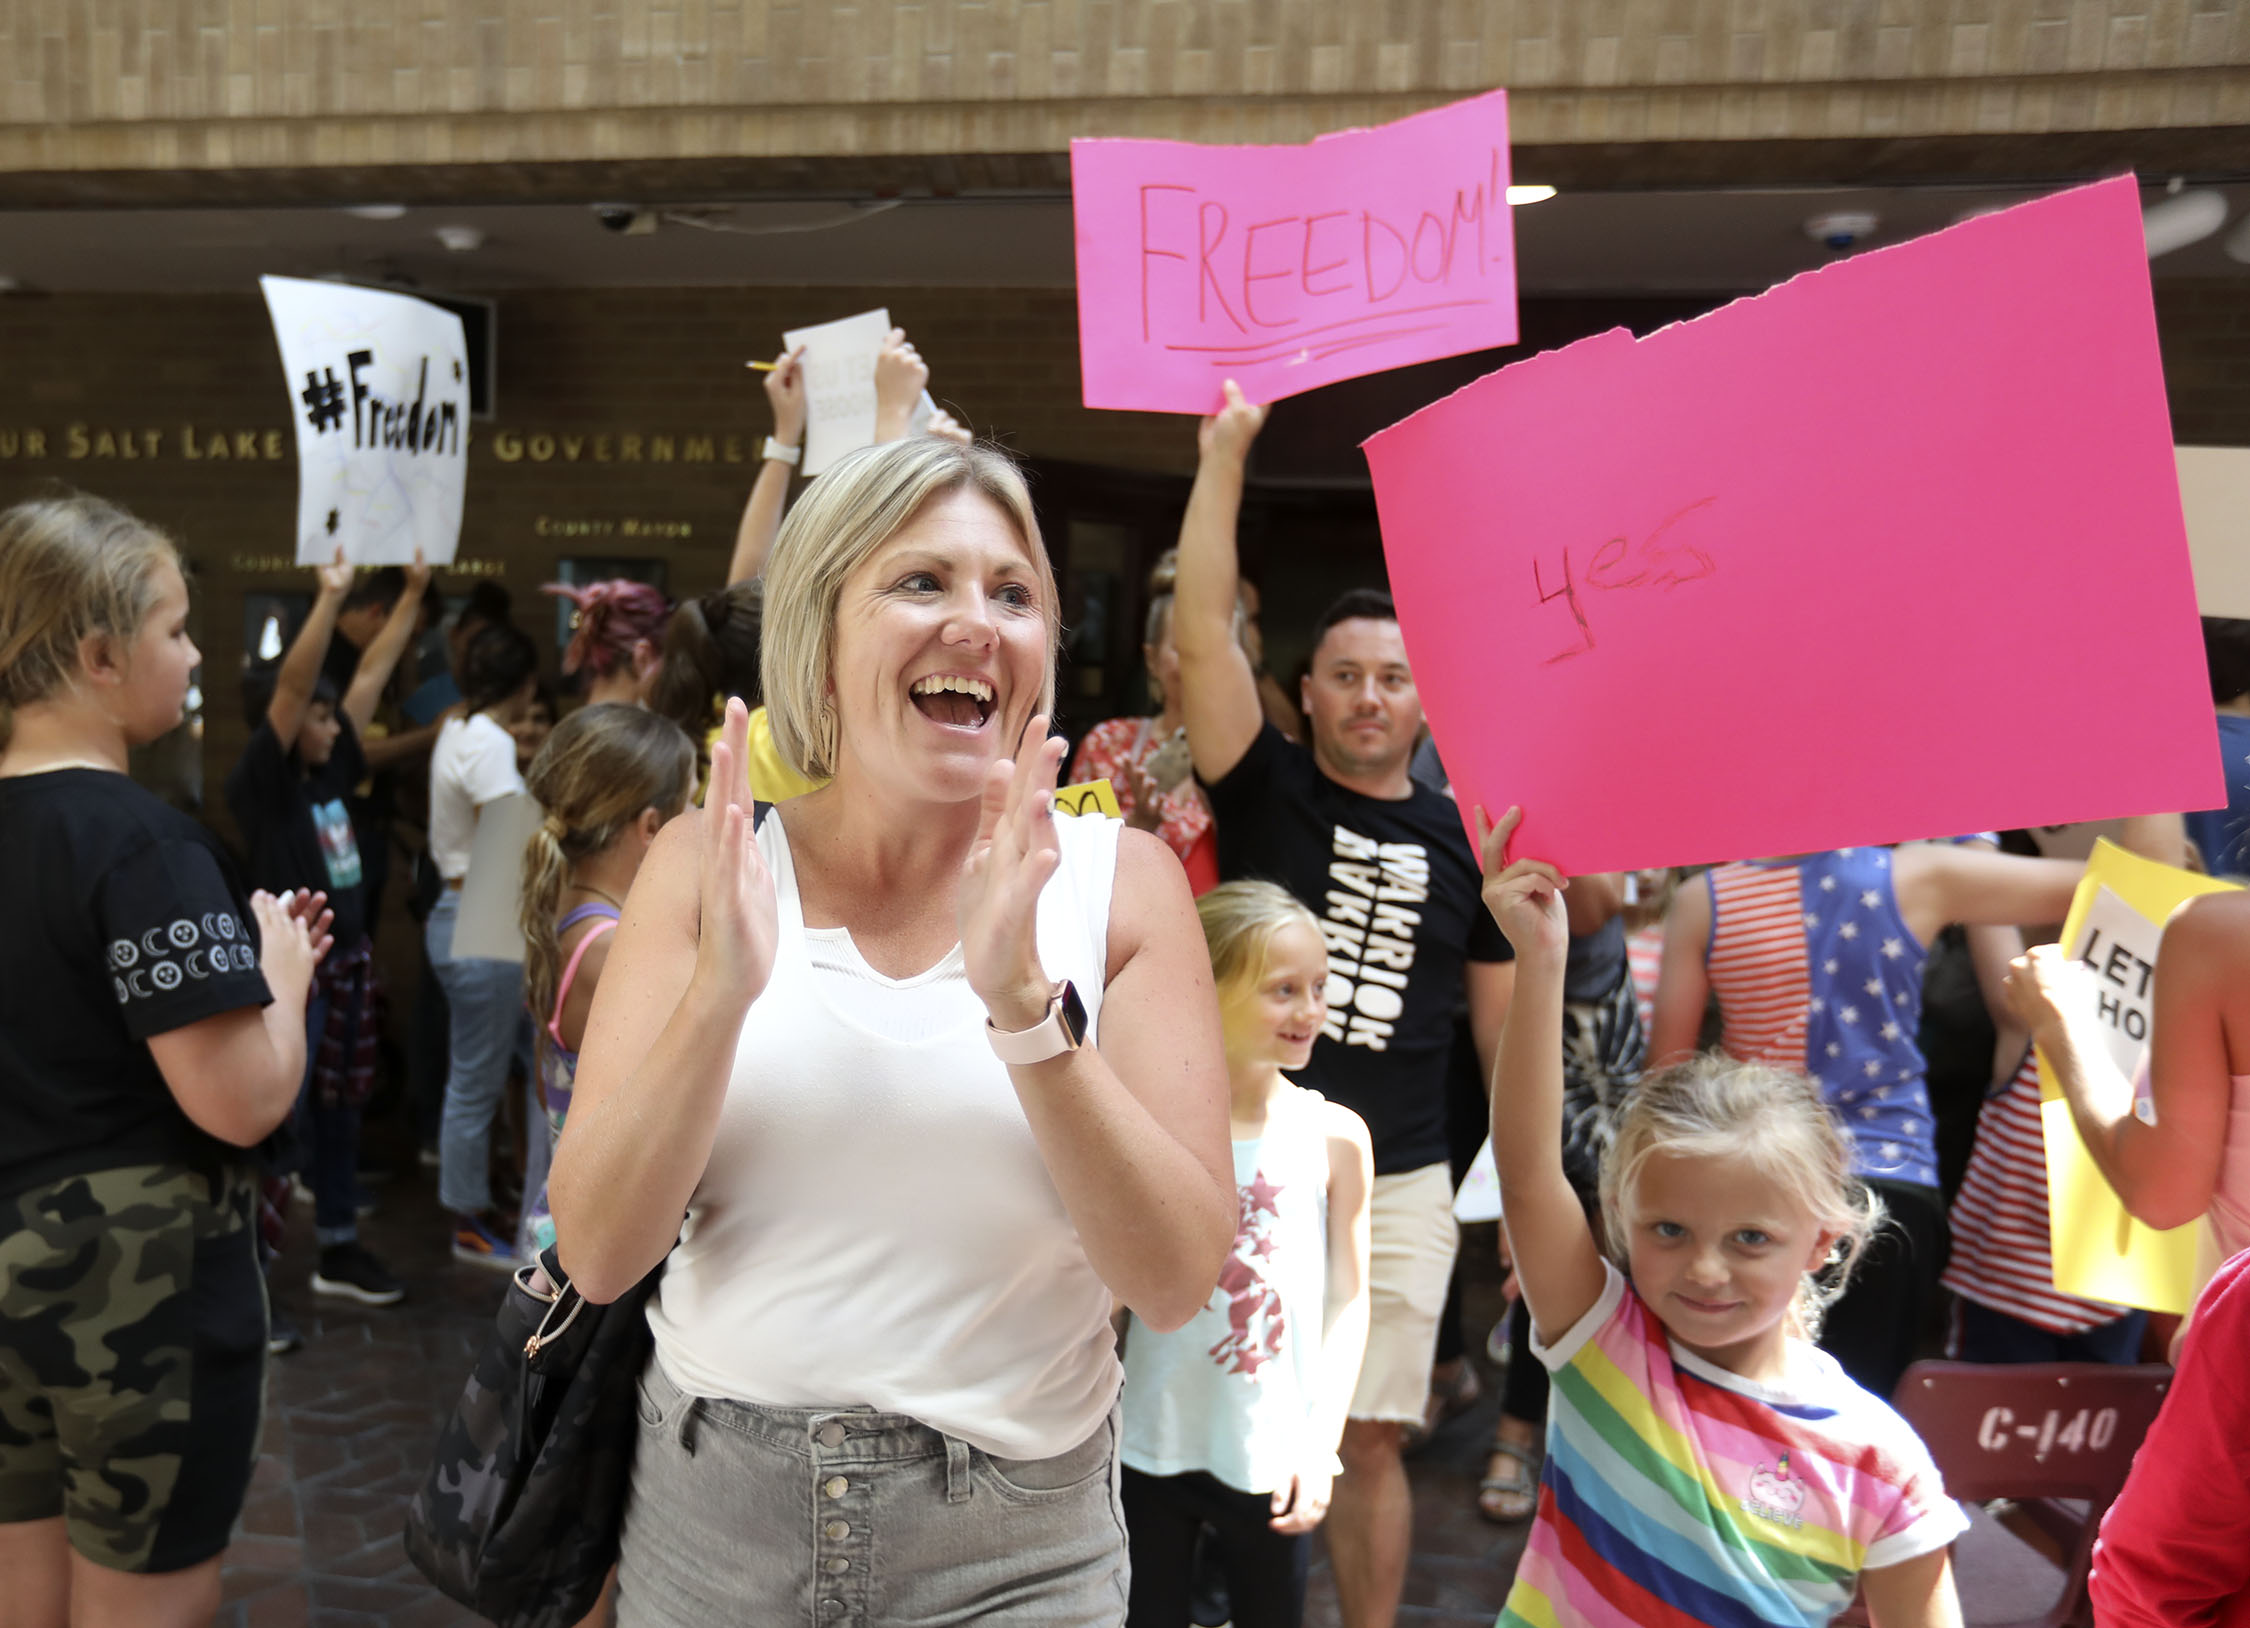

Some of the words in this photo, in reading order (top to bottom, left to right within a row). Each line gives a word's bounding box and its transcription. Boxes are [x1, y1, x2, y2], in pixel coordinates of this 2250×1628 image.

[1140, 146, 1502, 344] FREEDOM!
[66, 423, 163, 460] SALT
[184, 424, 284, 460] LAKE
[1530, 495, 1719, 667] yes
[2082, 927, 2153, 999] LET
[1977, 1406, 2119, 1453] C-140
